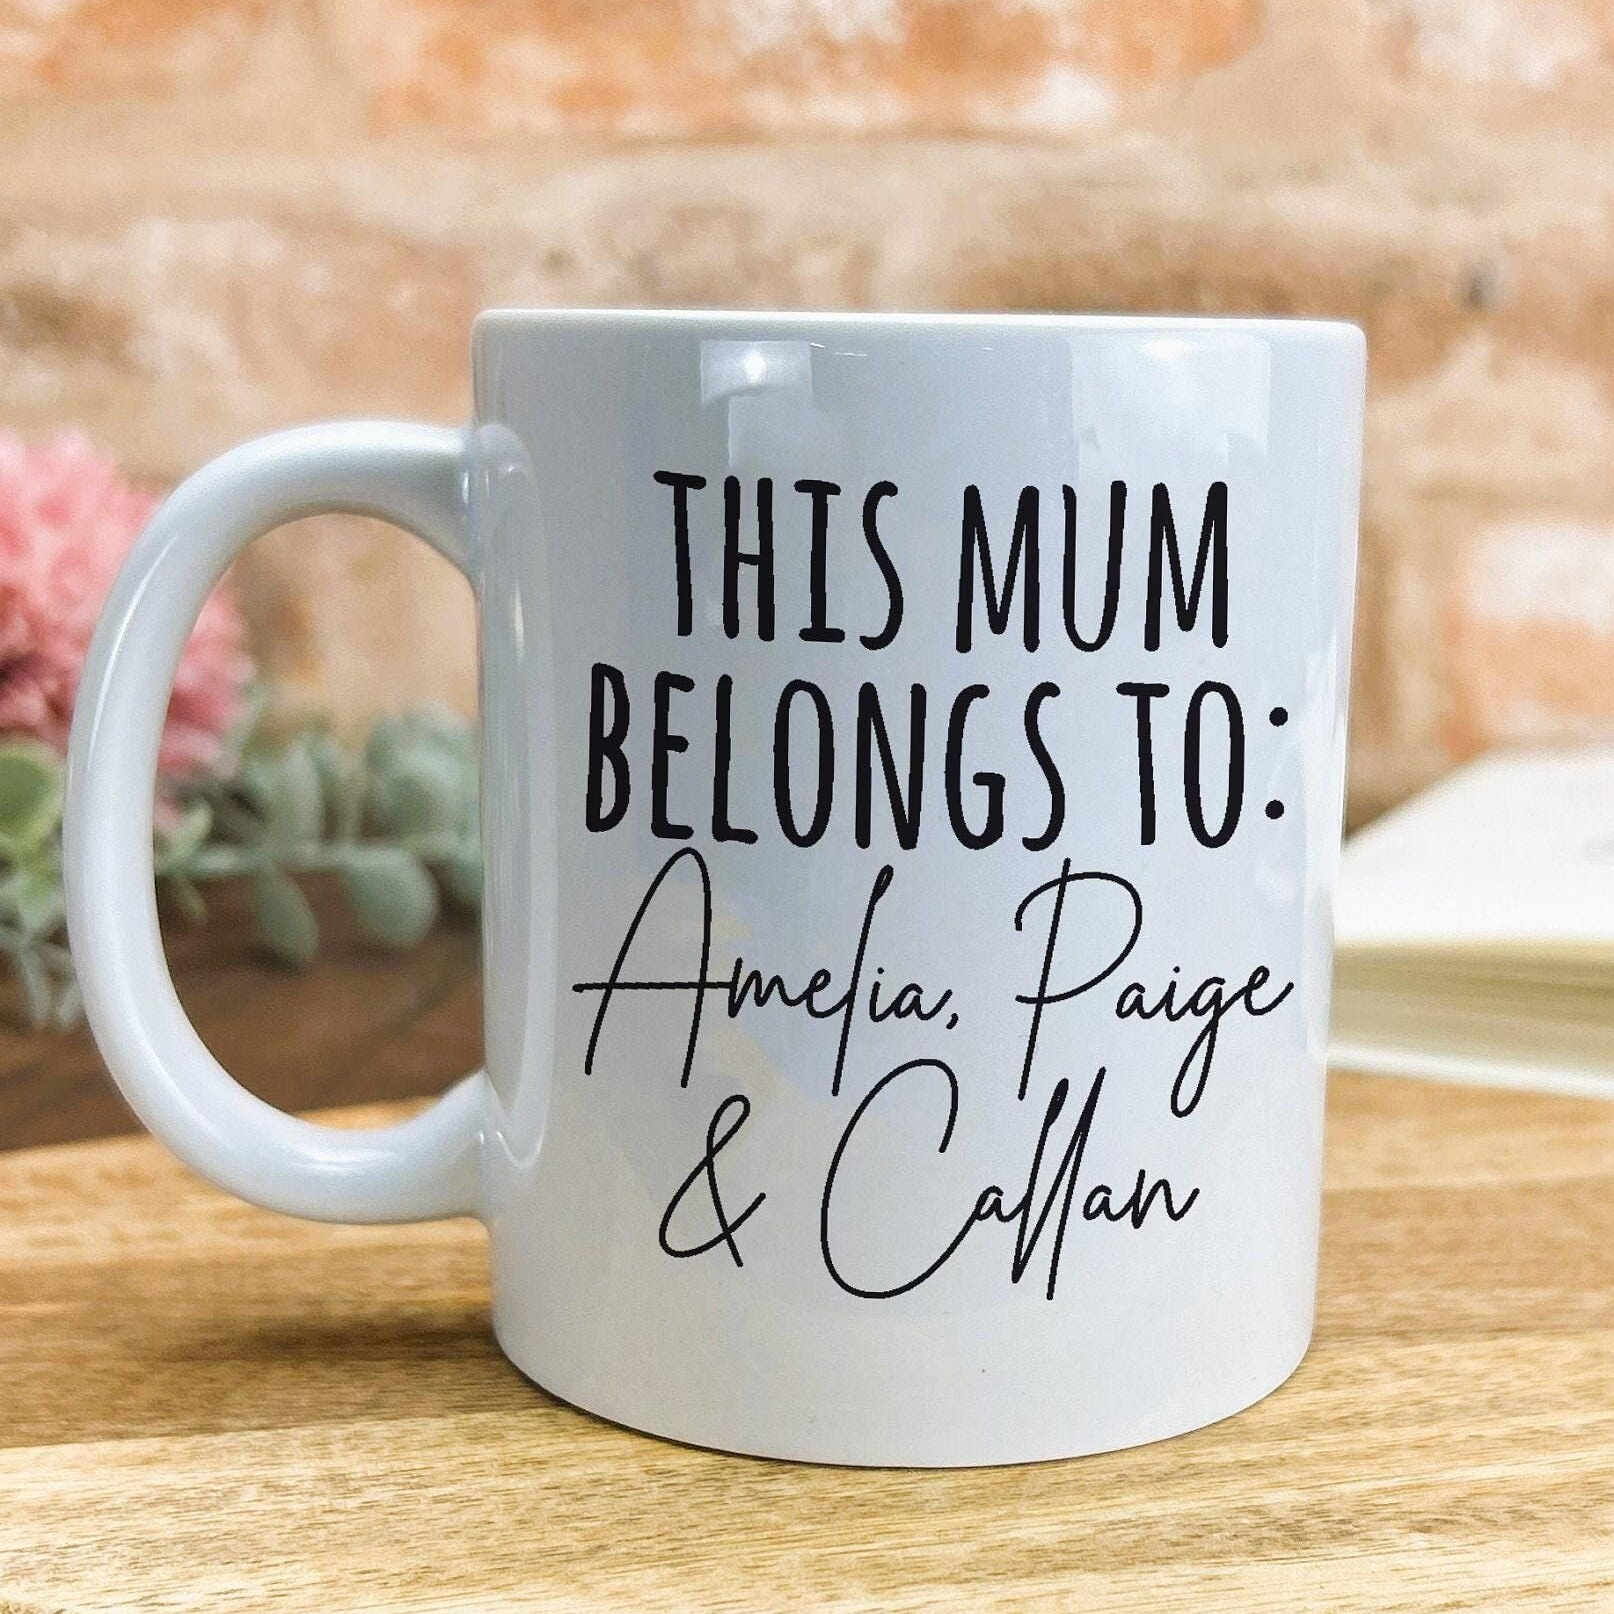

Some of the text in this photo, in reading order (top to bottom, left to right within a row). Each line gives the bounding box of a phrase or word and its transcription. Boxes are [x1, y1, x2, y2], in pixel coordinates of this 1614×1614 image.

[653, 470, 1229, 653] THIS MUM
[586, 662, 1289, 851] BELONGS TO:
[572, 847, 1294, 1118] Amelia, Paige
[659, 1059, 1199, 1300] & Callan
